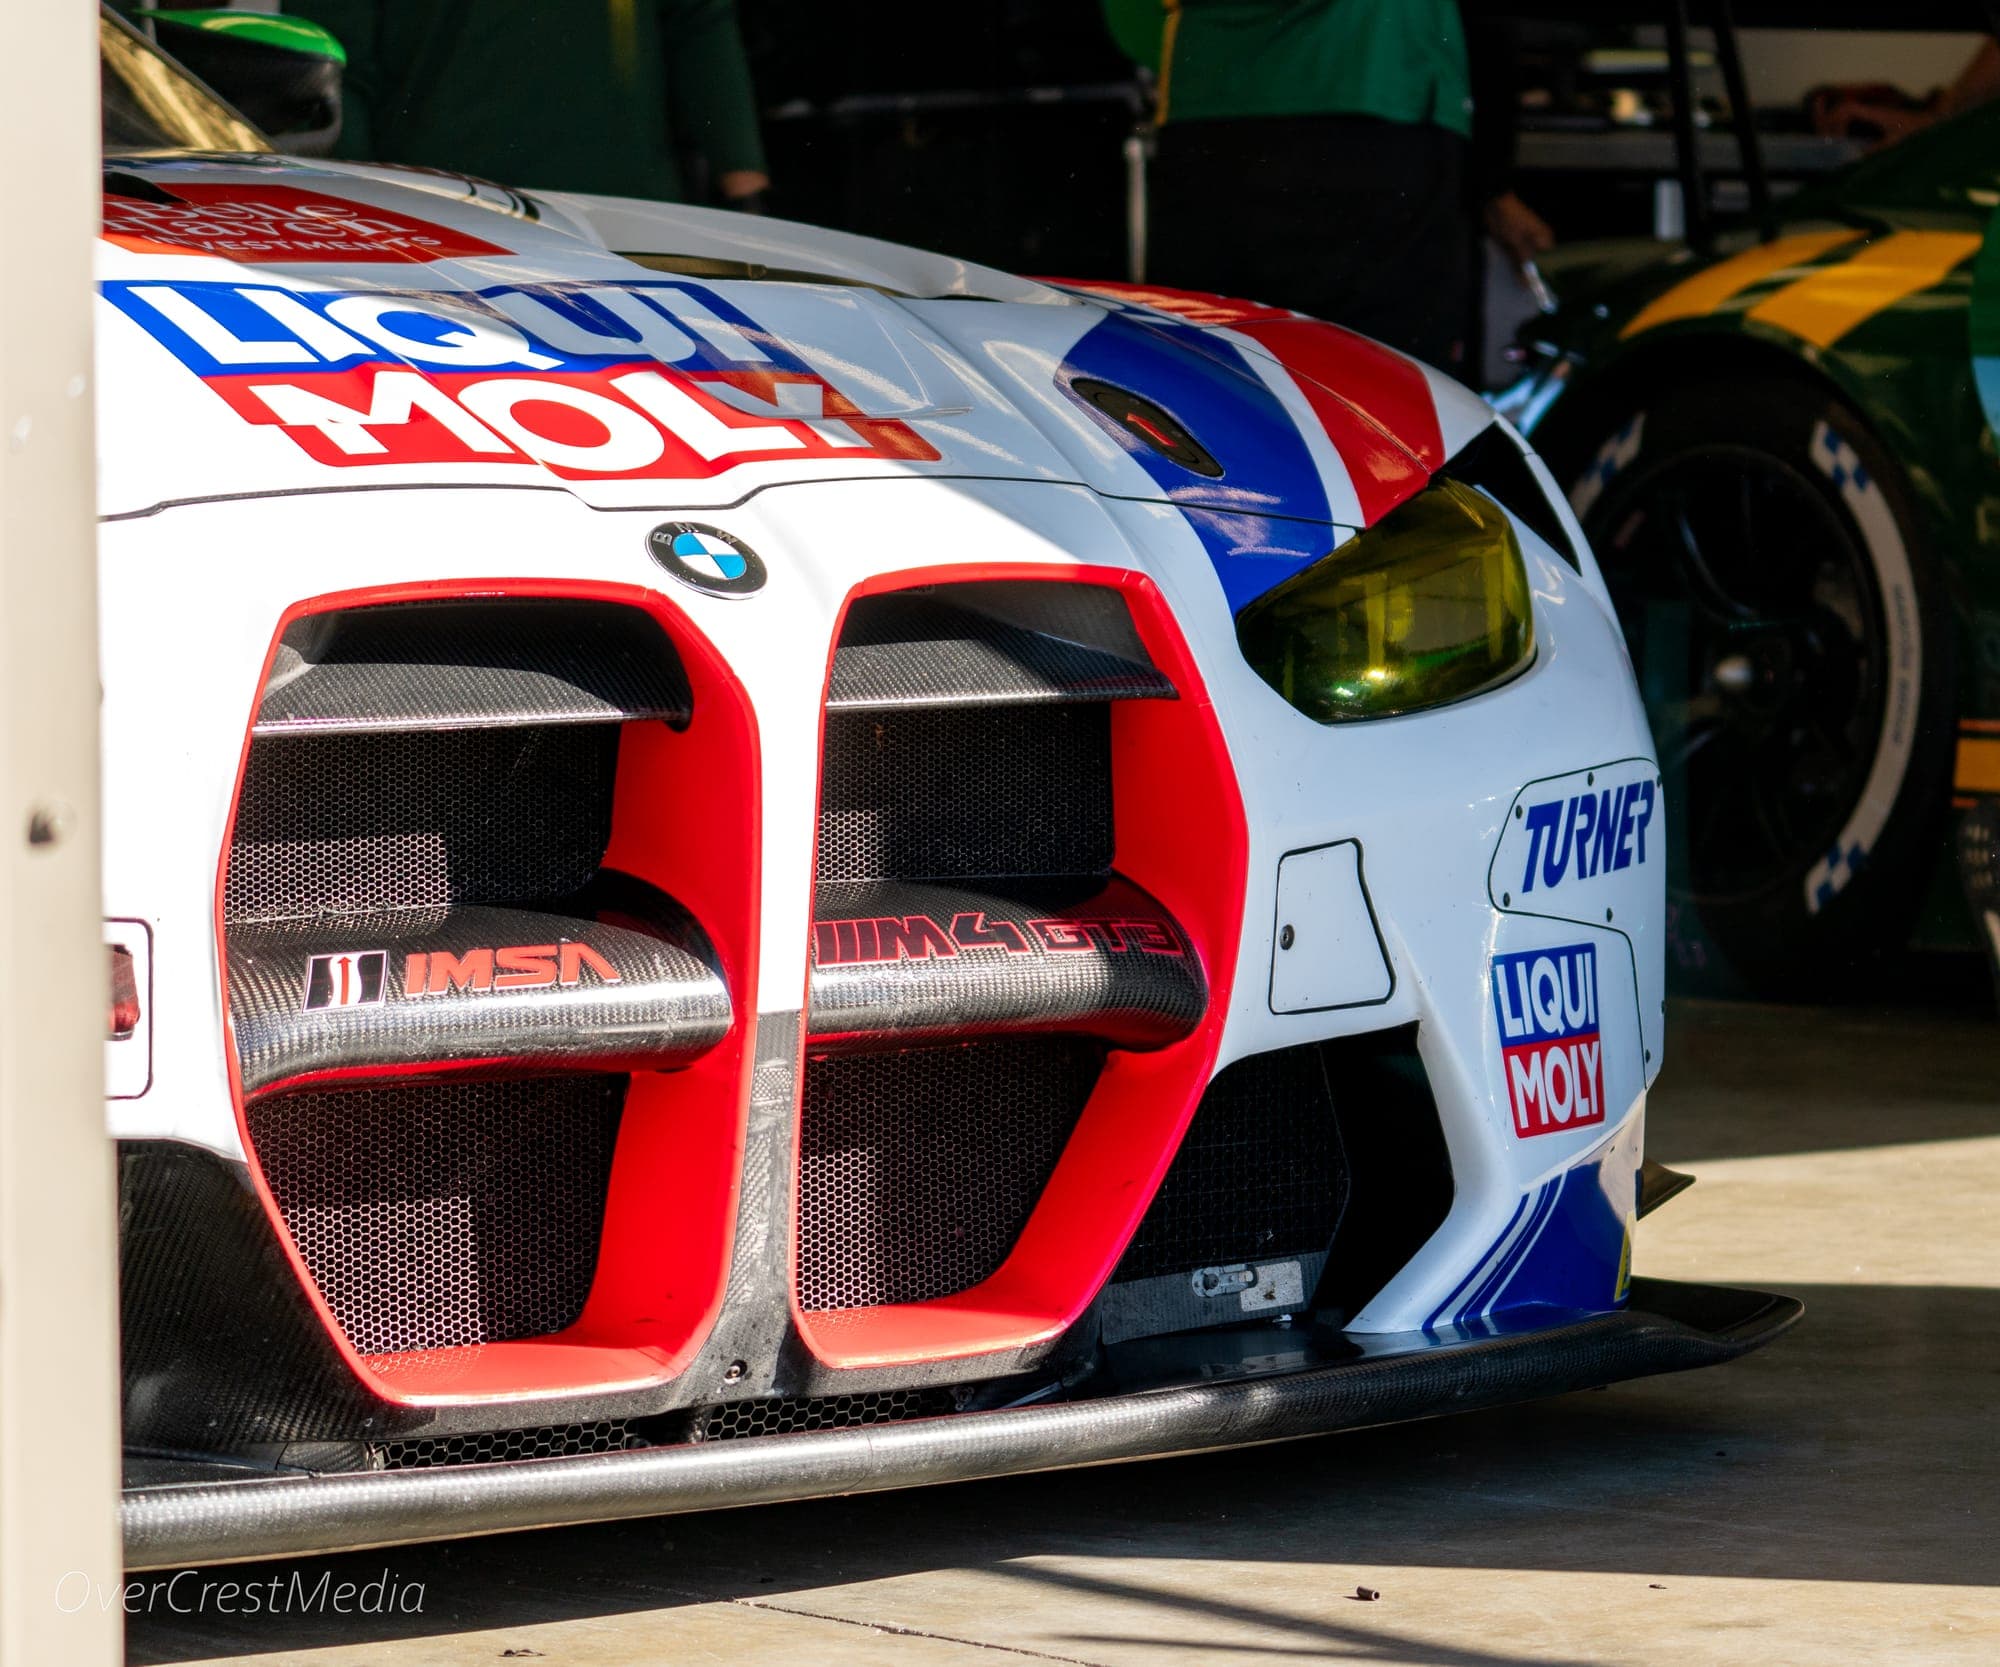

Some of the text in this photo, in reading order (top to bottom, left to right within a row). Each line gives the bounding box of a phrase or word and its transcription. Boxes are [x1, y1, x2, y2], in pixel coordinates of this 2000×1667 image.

[103, 216, 418, 237] Haven
[105, 201, 358, 220] Belle
[140, 235, 442, 251] INVESTMENTS
[127, 286, 773, 370] LIQUI
[248, 370, 875, 472] MOLY
[651, 521, 738, 546] BMW
[1521, 779, 1655, 893] TURNER
[1026, 917, 1184, 956] GT3
[404, 941, 622, 998] IMSA
[1495, 951, 1596, 1038] LIQUI
[1508, 1040, 1600, 1130] MOLY
